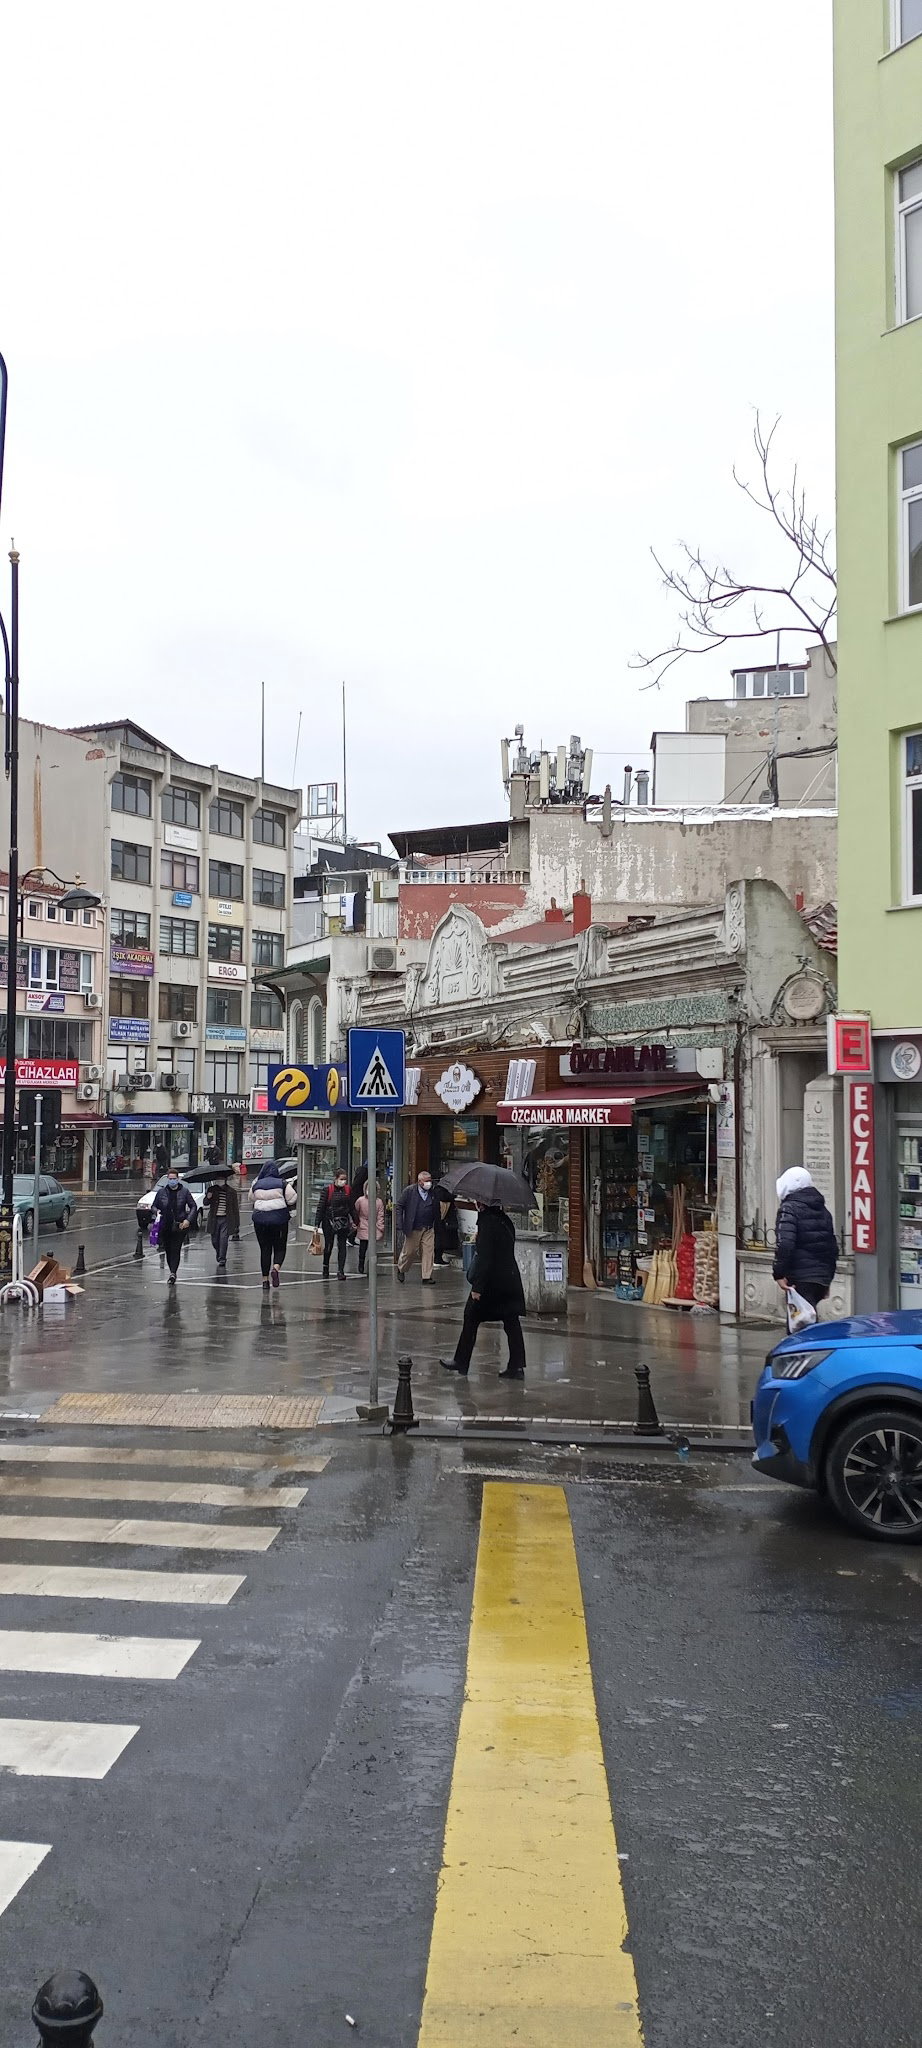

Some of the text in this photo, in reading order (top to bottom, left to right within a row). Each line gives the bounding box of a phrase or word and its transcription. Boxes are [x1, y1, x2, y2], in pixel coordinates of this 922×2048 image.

[218, 966, 238, 977] ERGO
[17, 1066, 77, 1080] CİHAZLARI
[511, 1107, 611, 1124] ÖZCANLAR MARKET
[853, 1086, 872, 1249] ECZANE
